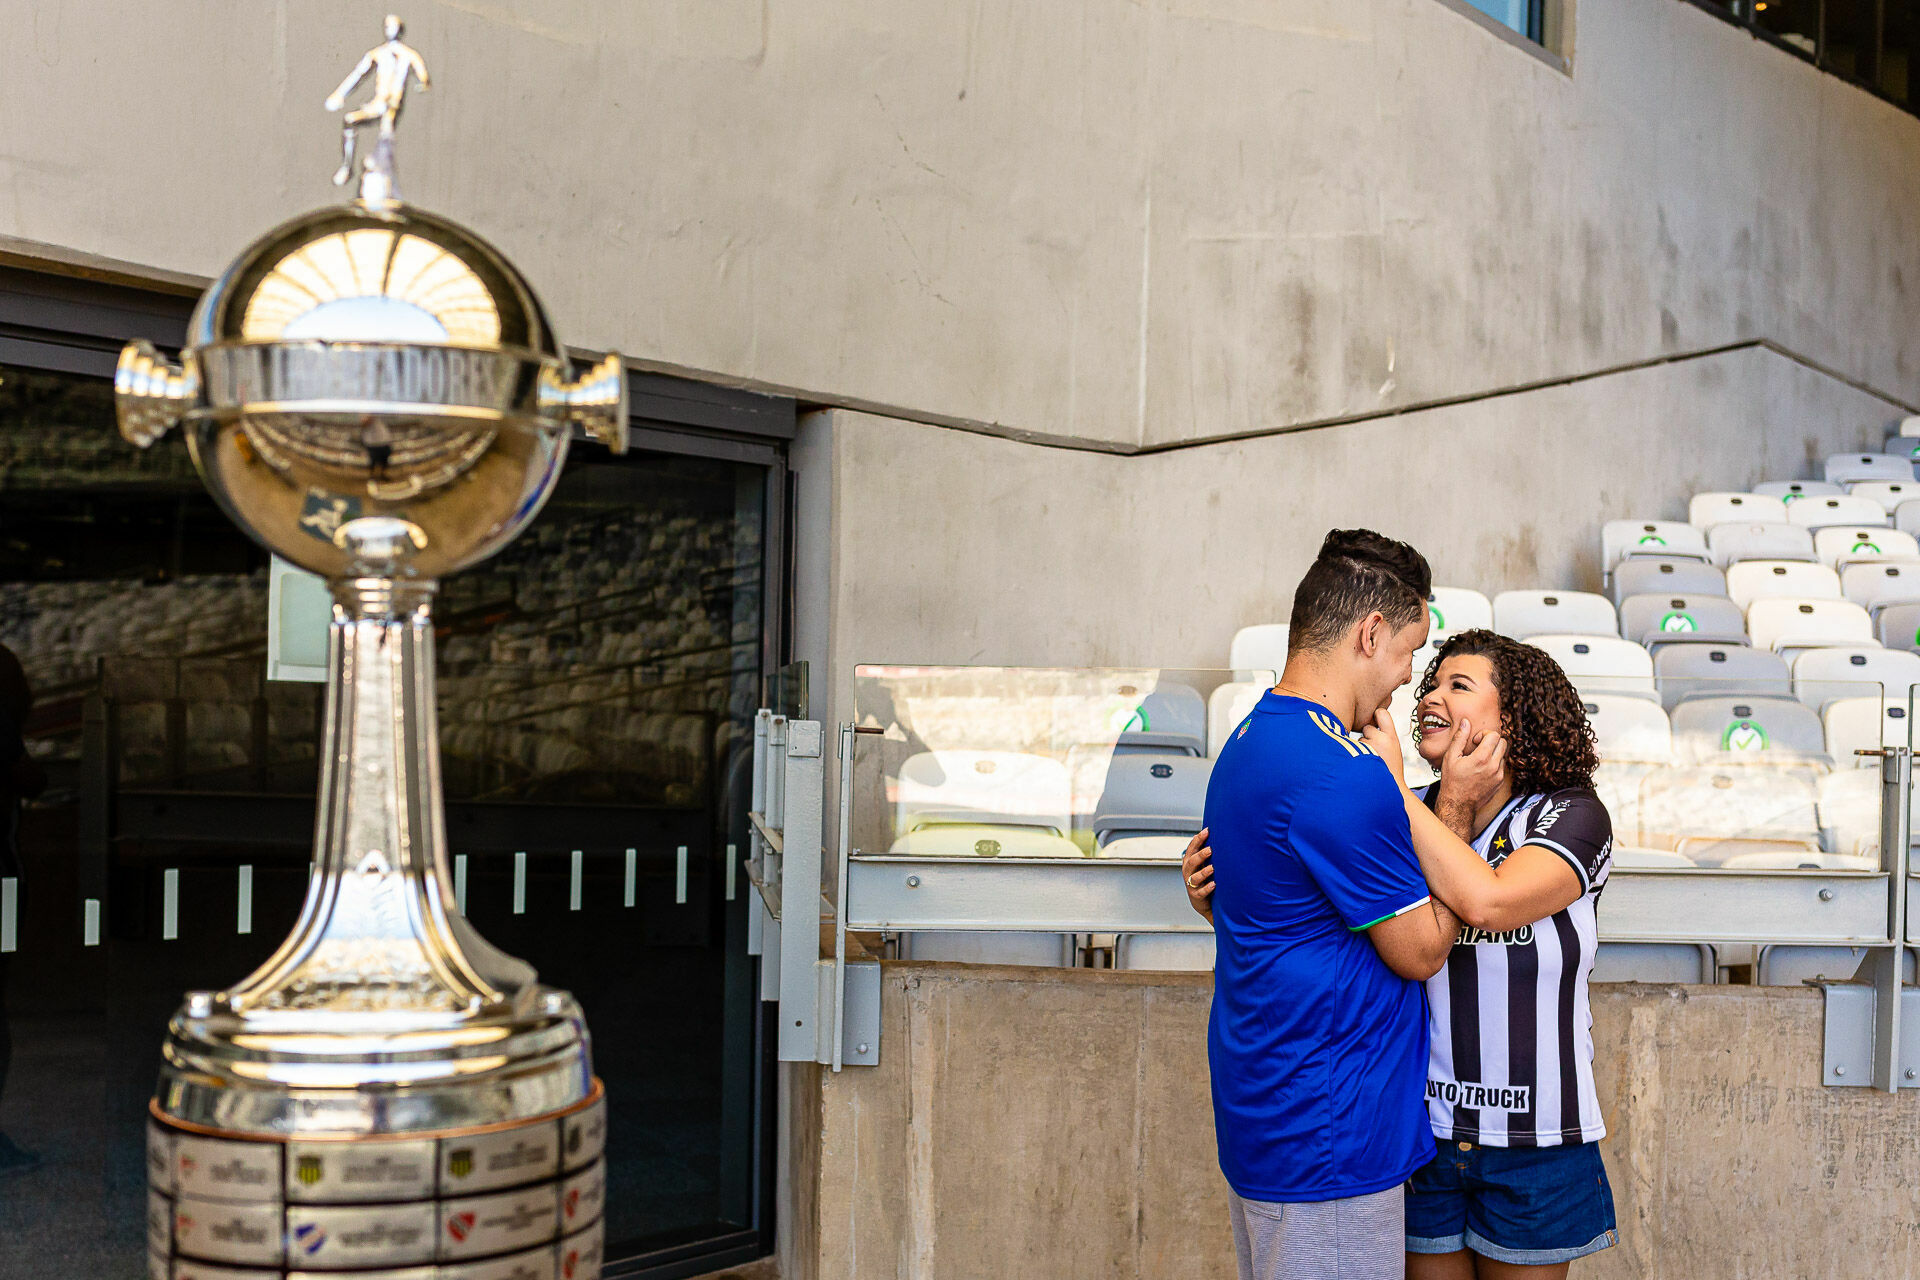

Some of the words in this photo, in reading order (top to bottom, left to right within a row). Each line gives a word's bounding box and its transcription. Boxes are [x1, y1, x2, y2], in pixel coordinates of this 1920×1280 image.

[1534, 807, 1567, 836] MRV
[1426, 1079, 1457, 1101] UTO
[1464, 1085, 1526, 1109] TRUCK
